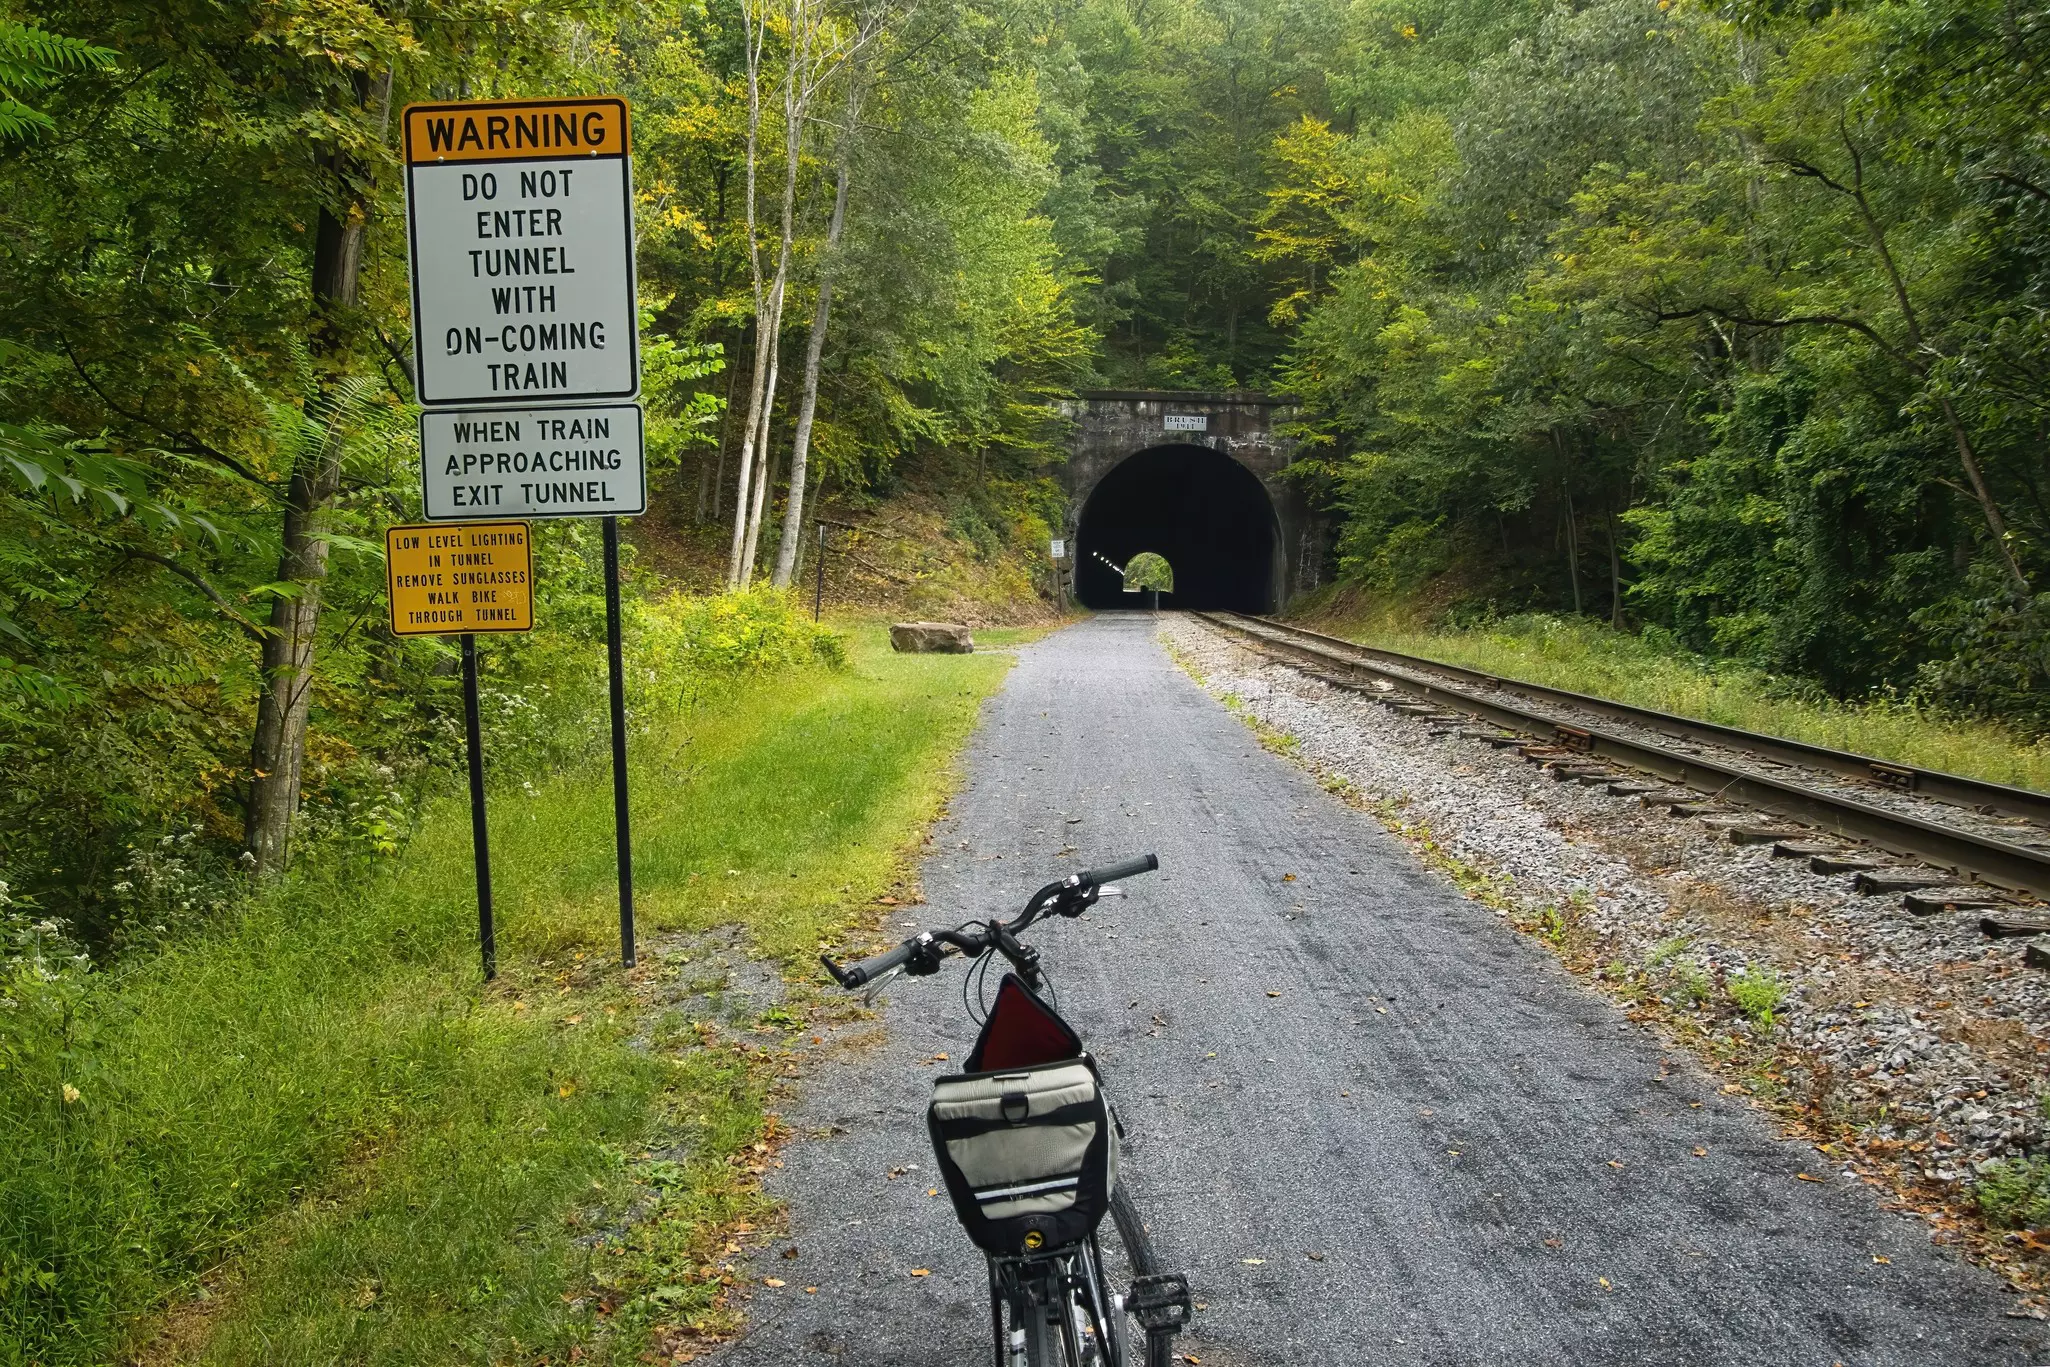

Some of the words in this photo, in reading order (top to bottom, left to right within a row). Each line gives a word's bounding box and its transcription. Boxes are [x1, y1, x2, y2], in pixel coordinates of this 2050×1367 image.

[426, 111, 606, 152] WARNING
[462, 172, 497, 201] DO
[520, 169, 573, 199] NOT
[477, 208, 563, 239] ENTER
[469, 246, 575, 277] TUNNEL
[492, 285, 556, 315] WITH
[446, 321, 605, 355] ON-COMING
[487, 361, 567, 391] TRAIN
[453, 420, 520, 444] WHEN
[536, 417, 610, 441] TRAIN
[445, 449, 622, 475] APPROACHING
[453, 484, 503, 507] EXIT
[520, 481, 615, 504] TUNNEL
[395, 536, 419, 550] LOW
[428, 534, 464, 549] LEVEL
[471, 532, 524, 547] LIGHTING
[429, 555, 441, 568] IN
[450, 552, 494, 567] TUNNEL
[396, 573, 443, 588] REMOVE
[453, 570, 526, 585] SUNGLASSES
[427, 591, 459, 605] WALK
[472, 590, 497, 603] BIKE
[408, 609, 463, 624] THROUGH
[476, 608, 517, 622] TUNNEL
